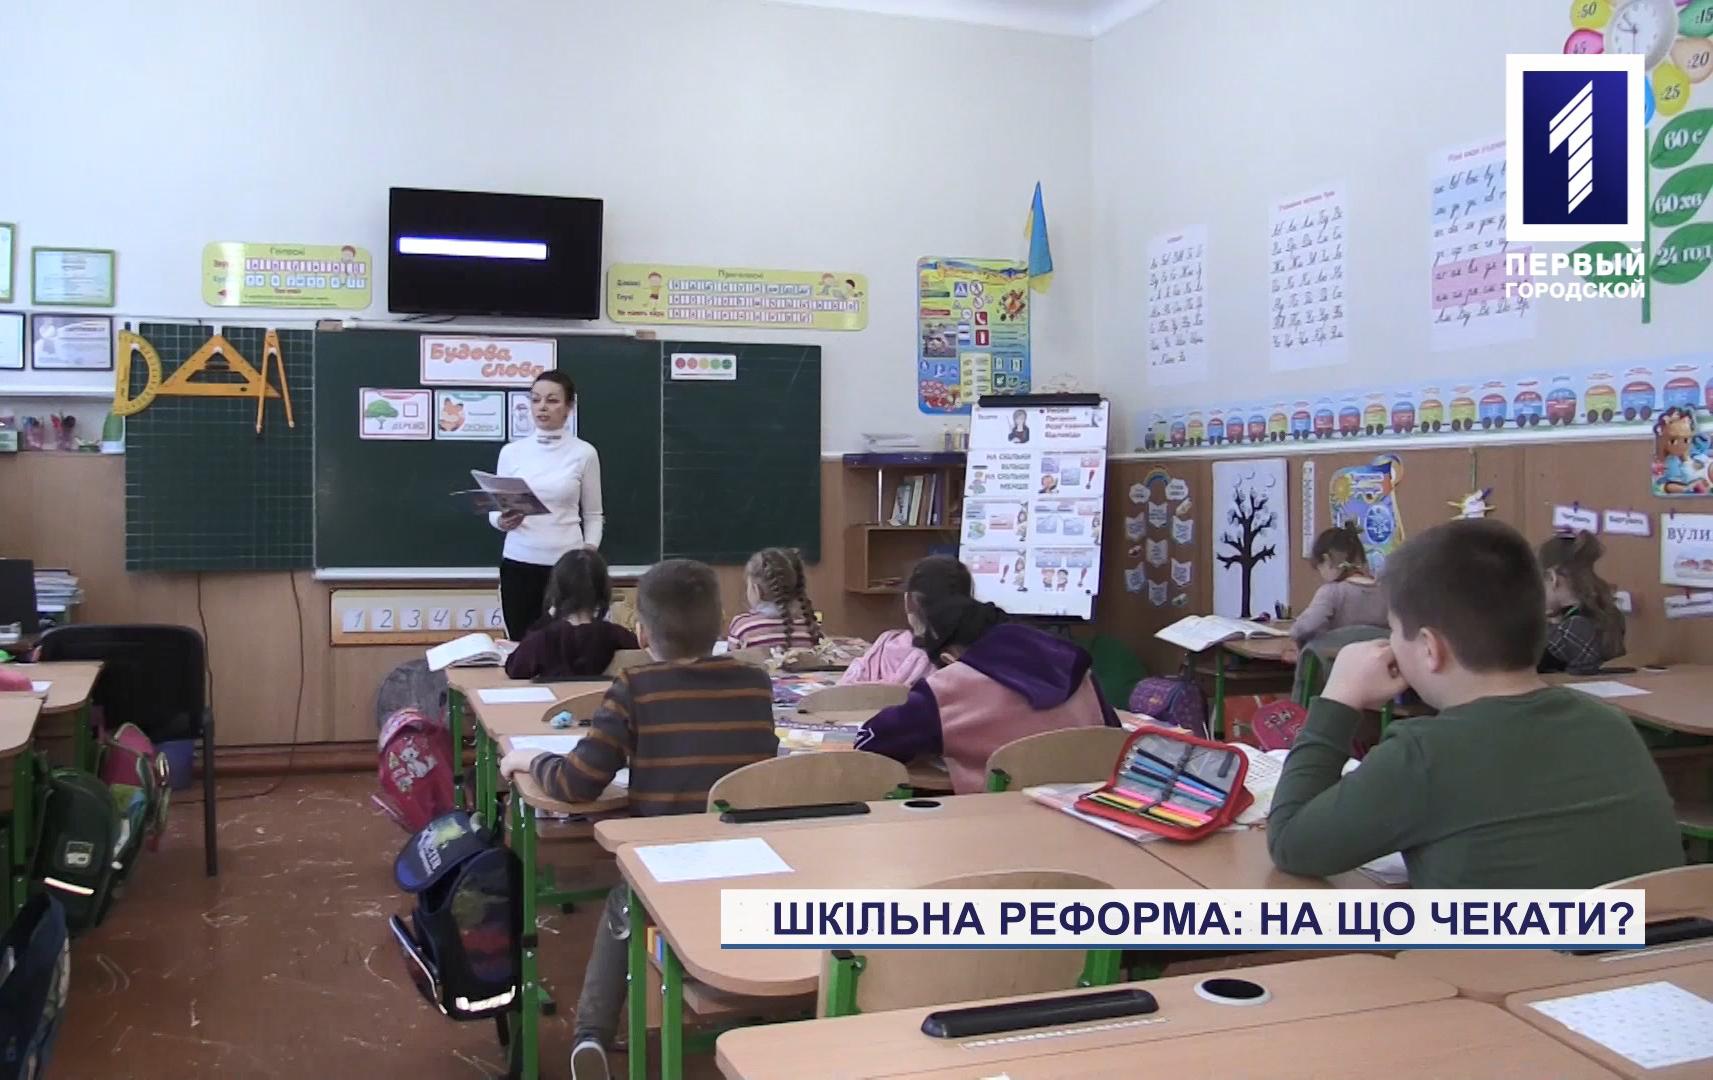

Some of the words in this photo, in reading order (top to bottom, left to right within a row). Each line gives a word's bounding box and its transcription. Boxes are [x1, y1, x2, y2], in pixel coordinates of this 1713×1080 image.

[430, 343, 512, 363] Будова
[354, 609, 364, 628] 1
[379, 609, 393, 628] 2
[407, 609, 421, 628] 3
[432, 609, 449, 627] 4
[462, 609, 476, 628] 5
[490, 607, 502, 626] 6
